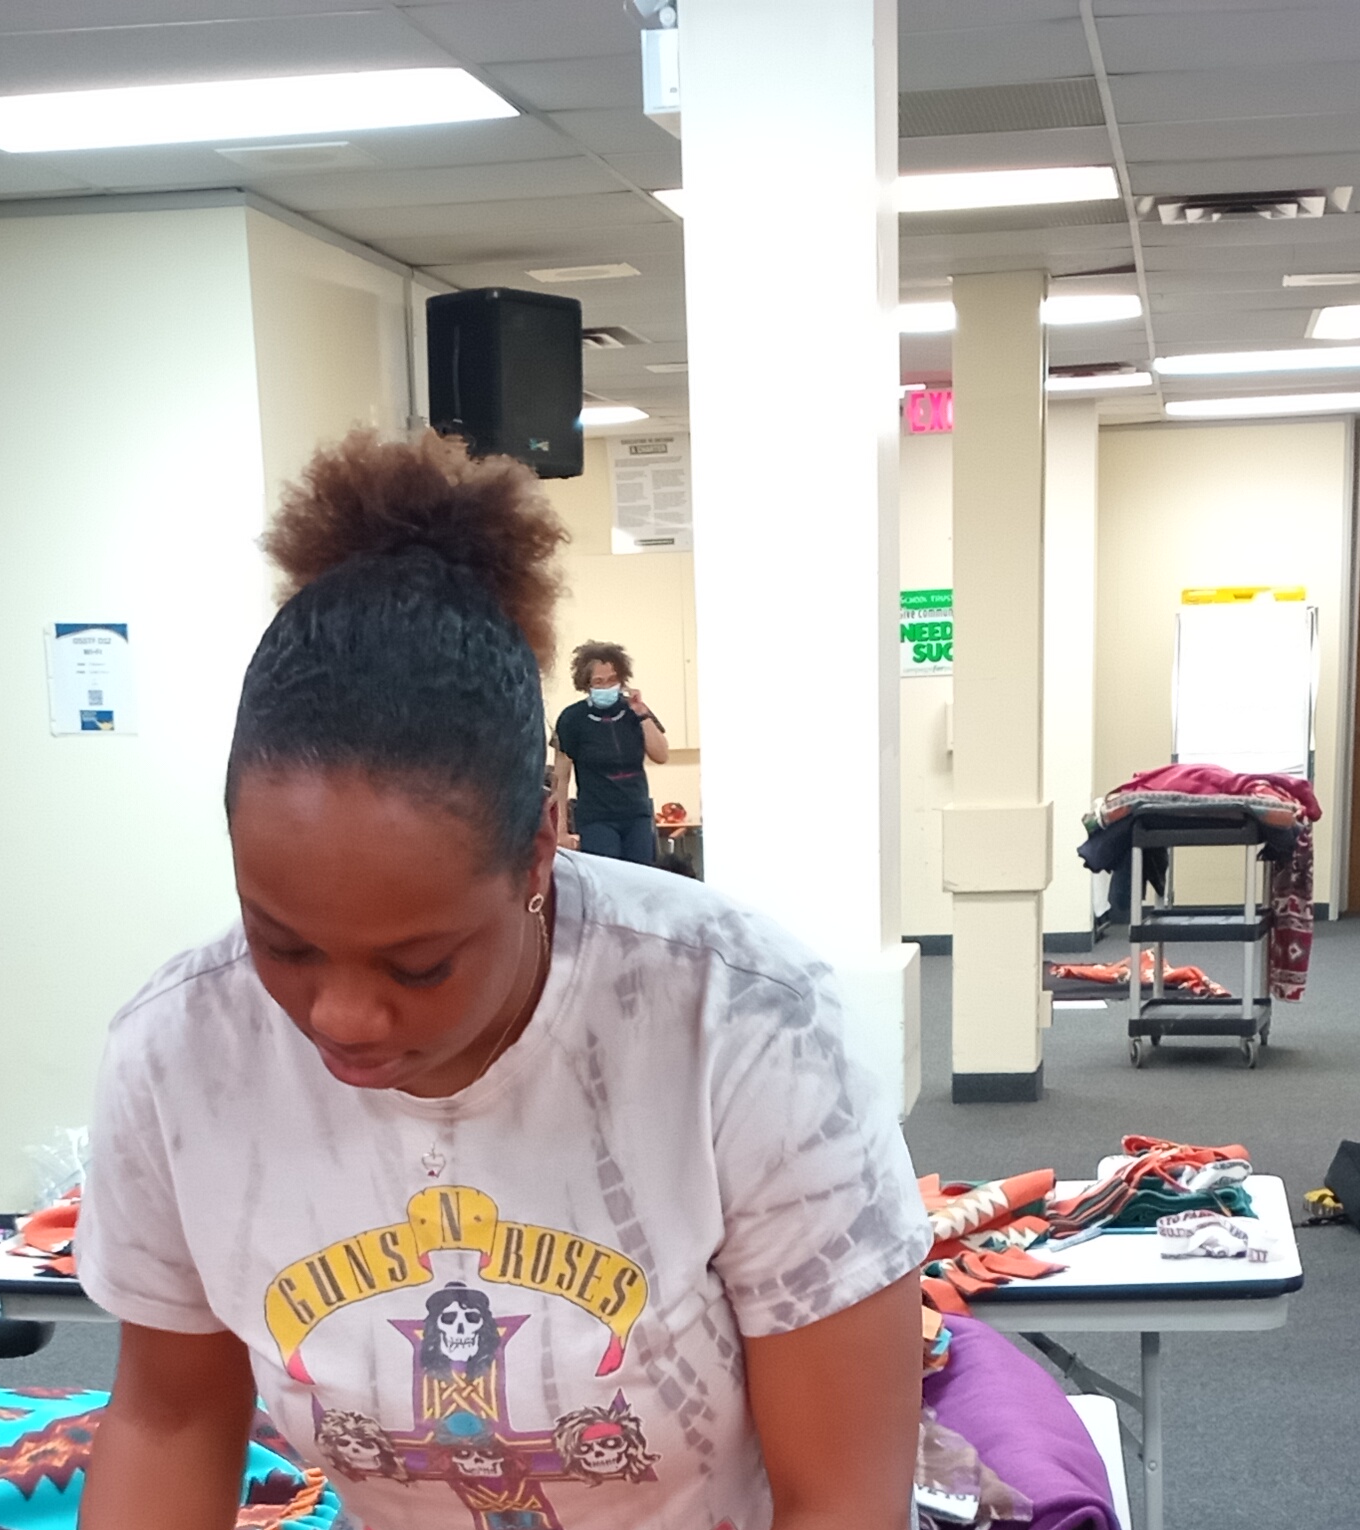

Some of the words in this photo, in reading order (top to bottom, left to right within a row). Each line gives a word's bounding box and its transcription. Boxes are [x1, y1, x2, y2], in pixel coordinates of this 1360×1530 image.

[911, 392, 952, 431] EXI
[278, 1230, 407, 1325] GUNS
[498, 1226, 639, 1320] ROSES
